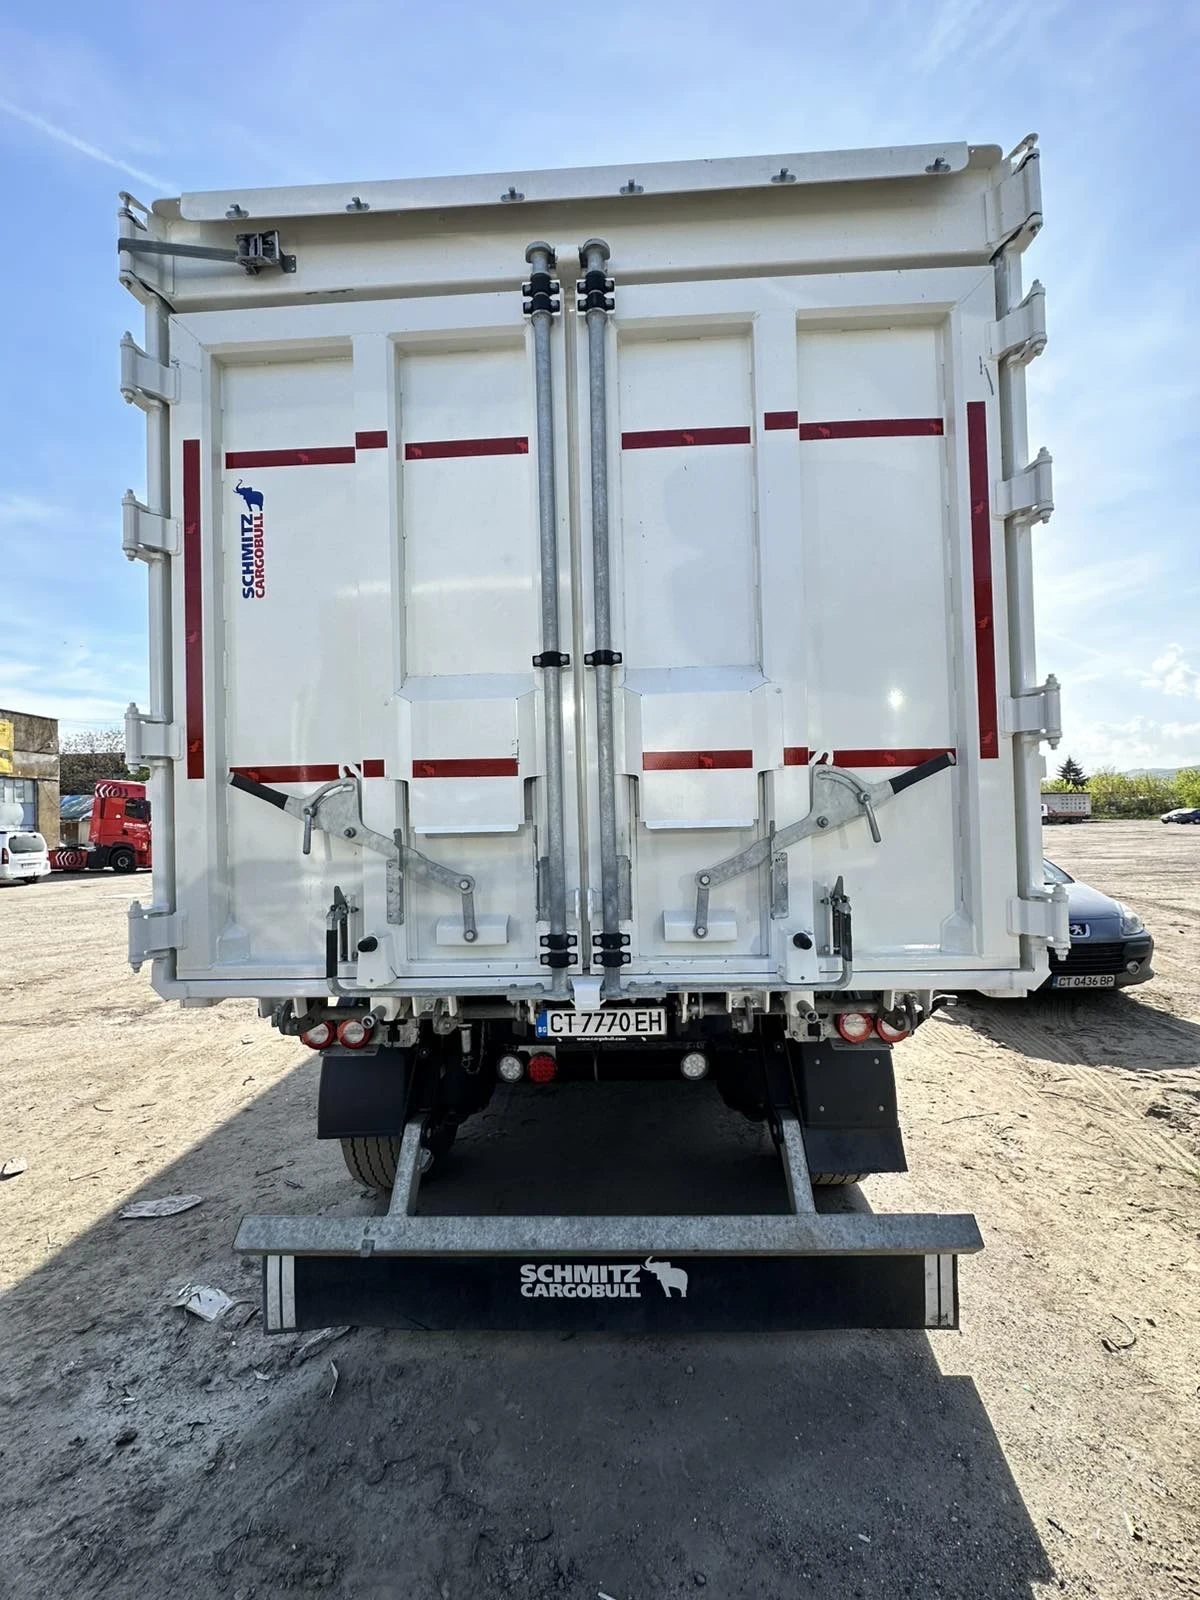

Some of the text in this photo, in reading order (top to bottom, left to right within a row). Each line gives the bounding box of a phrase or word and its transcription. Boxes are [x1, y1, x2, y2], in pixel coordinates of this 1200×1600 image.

[241, 514, 254, 598] SCHMITZ
[254, 513, 265, 598] CARGOBULL
[1059, 975, 1113, 986] CT 0436 BP
[550, 1011, 662, 1033] CT 7770 EH
[520, 1264, 640, 1283] SCHMITZ
[520, 1283, 641, 1298] CARGOBULL
